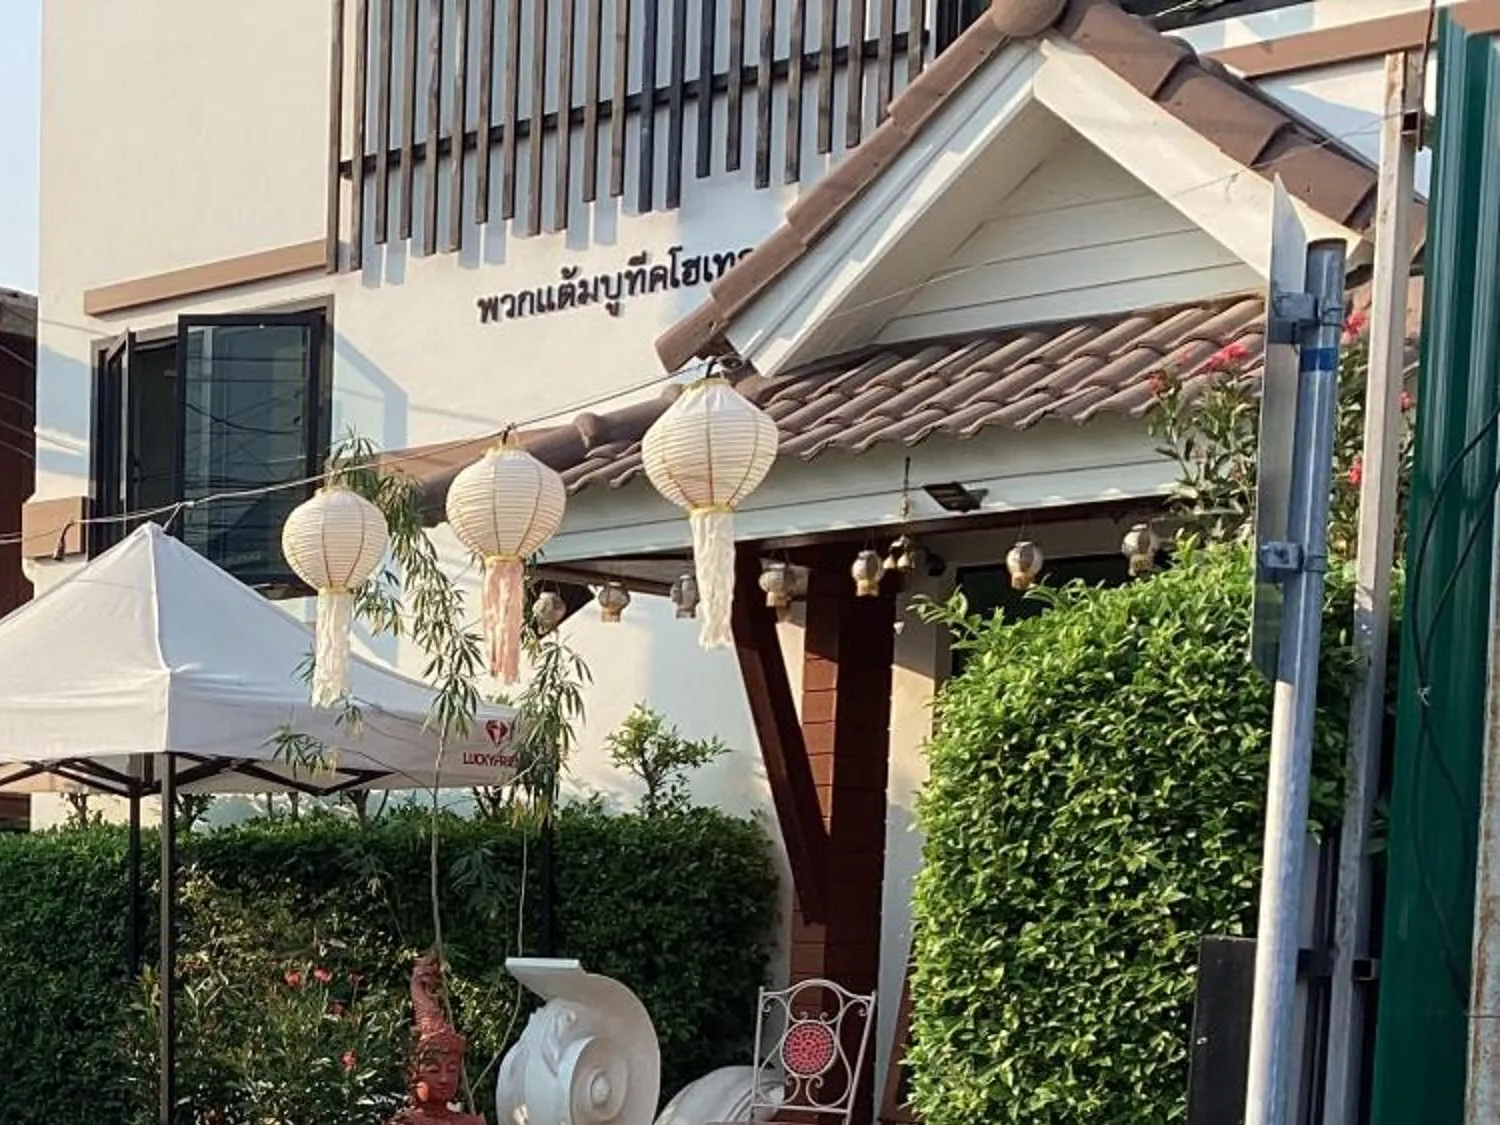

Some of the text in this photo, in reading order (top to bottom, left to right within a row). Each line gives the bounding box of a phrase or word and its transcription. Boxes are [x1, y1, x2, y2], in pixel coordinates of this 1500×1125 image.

[476, 246, 755, 323] พวกแต้มบูทีคโฮเท
